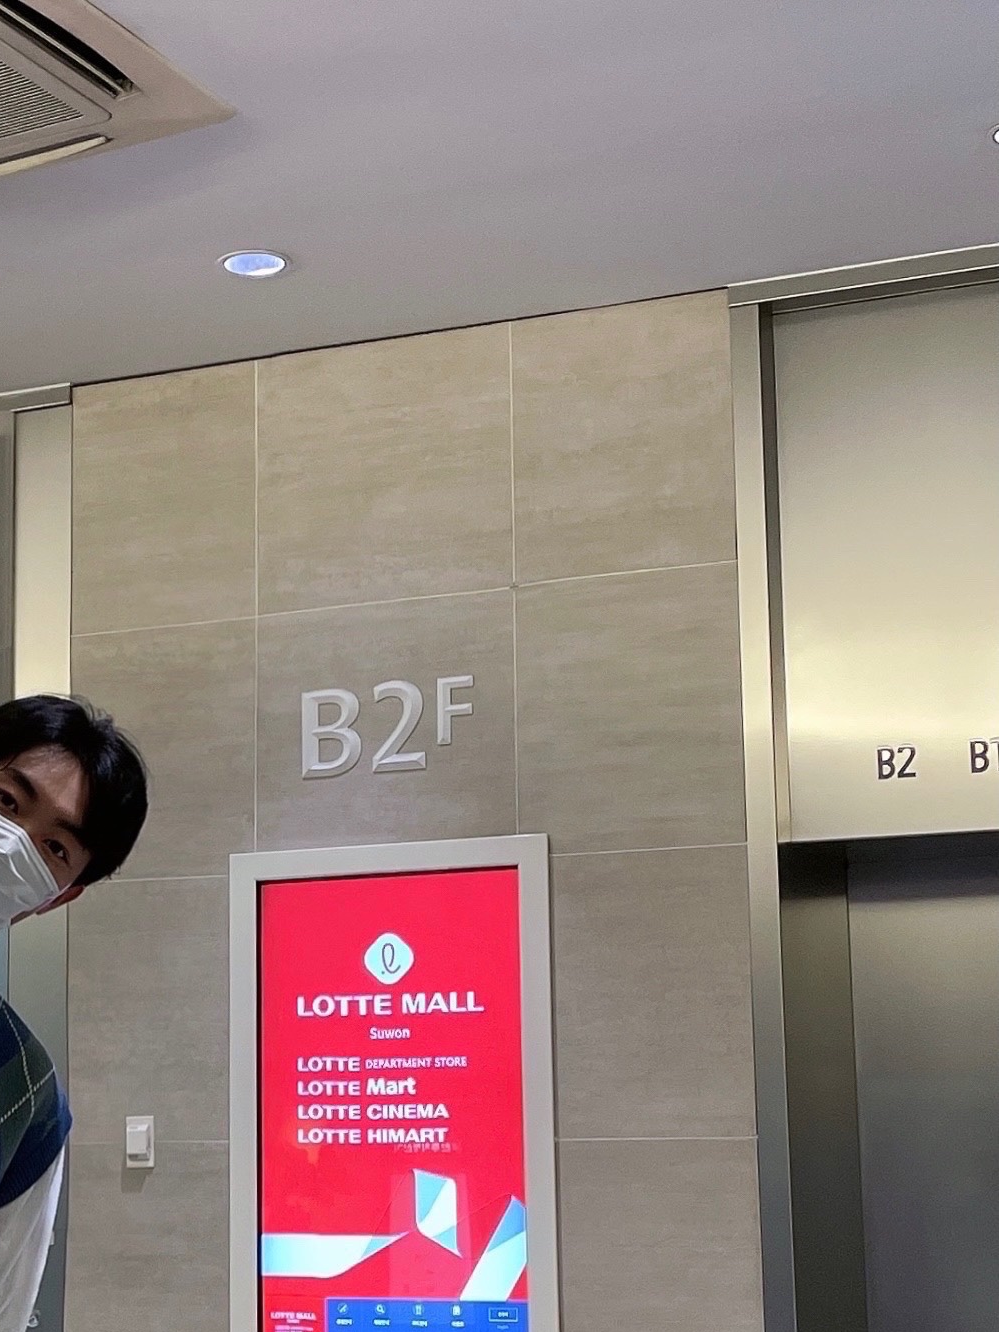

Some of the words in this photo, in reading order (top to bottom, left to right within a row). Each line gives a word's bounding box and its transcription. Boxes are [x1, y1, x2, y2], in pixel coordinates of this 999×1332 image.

[301, 675, 474, 780] B2F
[876, 747, 917, 780] B2
[296, 994, 393, 1017] LOTTE
[401, 991, 485, 1014] MALL
[369, 1026, 411, 1040] Suwon
[297, 1056, 361, 1072] LOTTE
[365, 1057, 432, 1070] DEPARTMENT
[434, 1056, 468, 1068] STORE
[297, 1080, 361, 1096] LOTTE
[366, 1077, 417, 1096] Mart
[297, 1104, 361, 1120] LOTTE
[366, 1103, 450, 1119] CINEMA
[297, 1128, 361, 1144] LOTTE
[367, 1127, 448, 1144] HIMART
